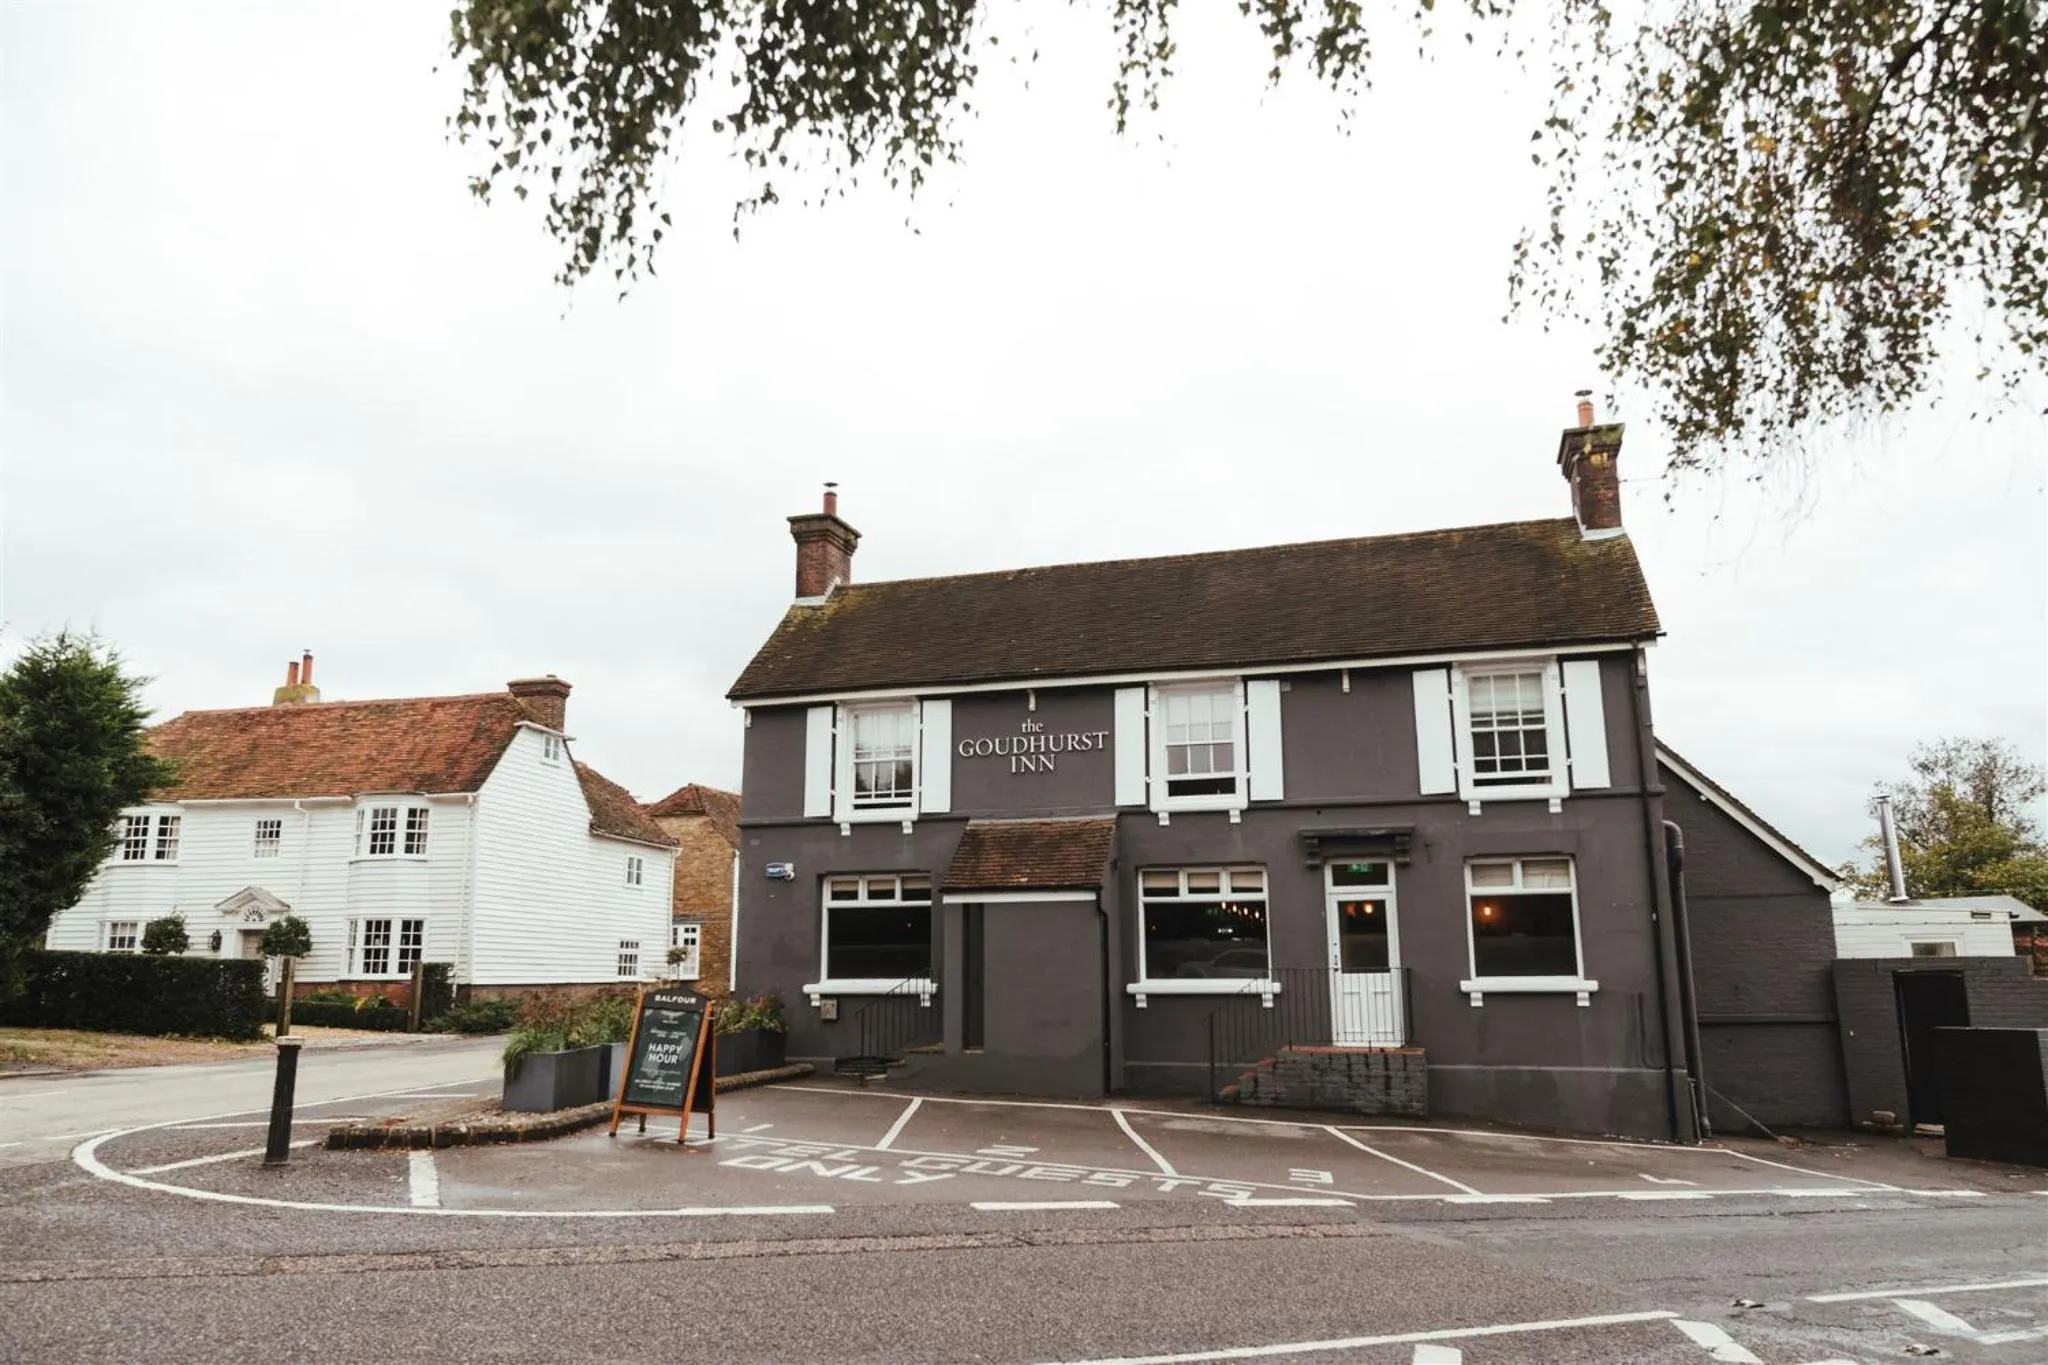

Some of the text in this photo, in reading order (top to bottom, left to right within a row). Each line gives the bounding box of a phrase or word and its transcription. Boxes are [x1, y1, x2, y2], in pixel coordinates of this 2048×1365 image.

[1021, 718, 1044, 733] the
[958, 730, 1109, 757] GOUDHURST
[1011, 754, 1055, 773] INN
[655, 994, 697, 1005] BALFOUR
[648, 1043, 682, 1054] HAPPY
[648, 1054, 678, 1064] HOUR
[718, 1155, 956, 1185] ONLY
[898, 1155, 1257, 1200] GUESTS
[1288, 1167, 1335, 1184] 3
